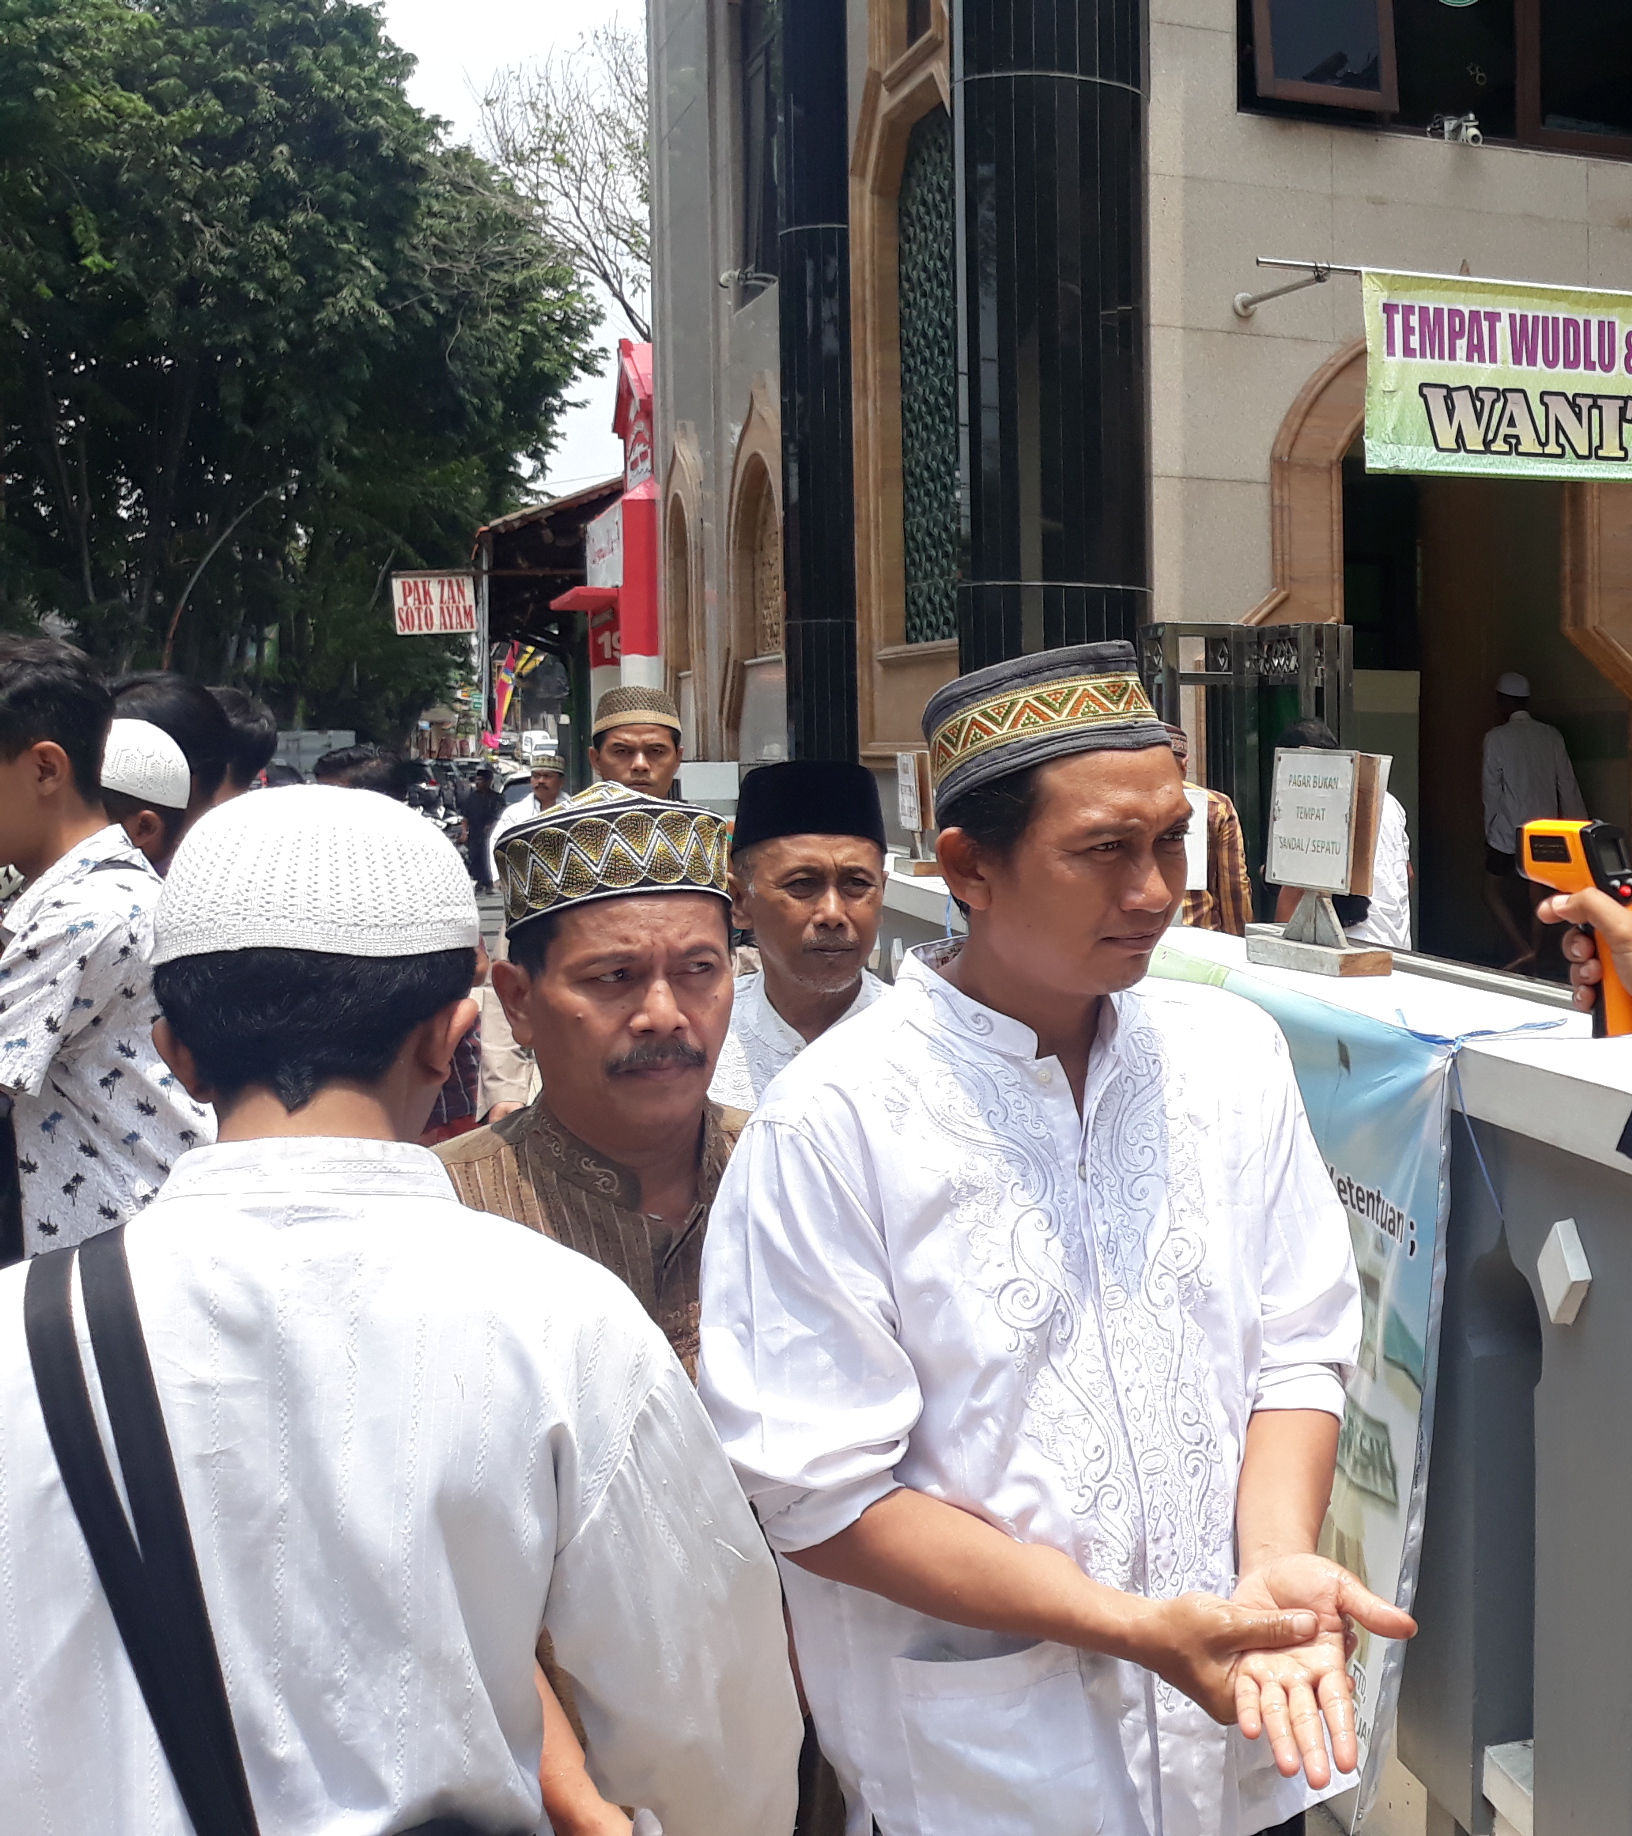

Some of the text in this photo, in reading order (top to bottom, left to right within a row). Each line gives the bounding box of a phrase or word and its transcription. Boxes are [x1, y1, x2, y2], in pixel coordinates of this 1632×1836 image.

[1381, 302, 1502, 365] TEMPAT
[1508, 312, 1617, 374] WUDLU
[400, 578, 467, 606] PAK ZAN
[397, 604, 475, 632] SOTO AYAM
[1288, 773, 1339, 790] PAGAR BUKAN
[1295, 805, 1326, 821] TEMPAT
[1278, 835, 1305, 852] SANDAL
[1311, 838, 1342, 856] SEPATU
